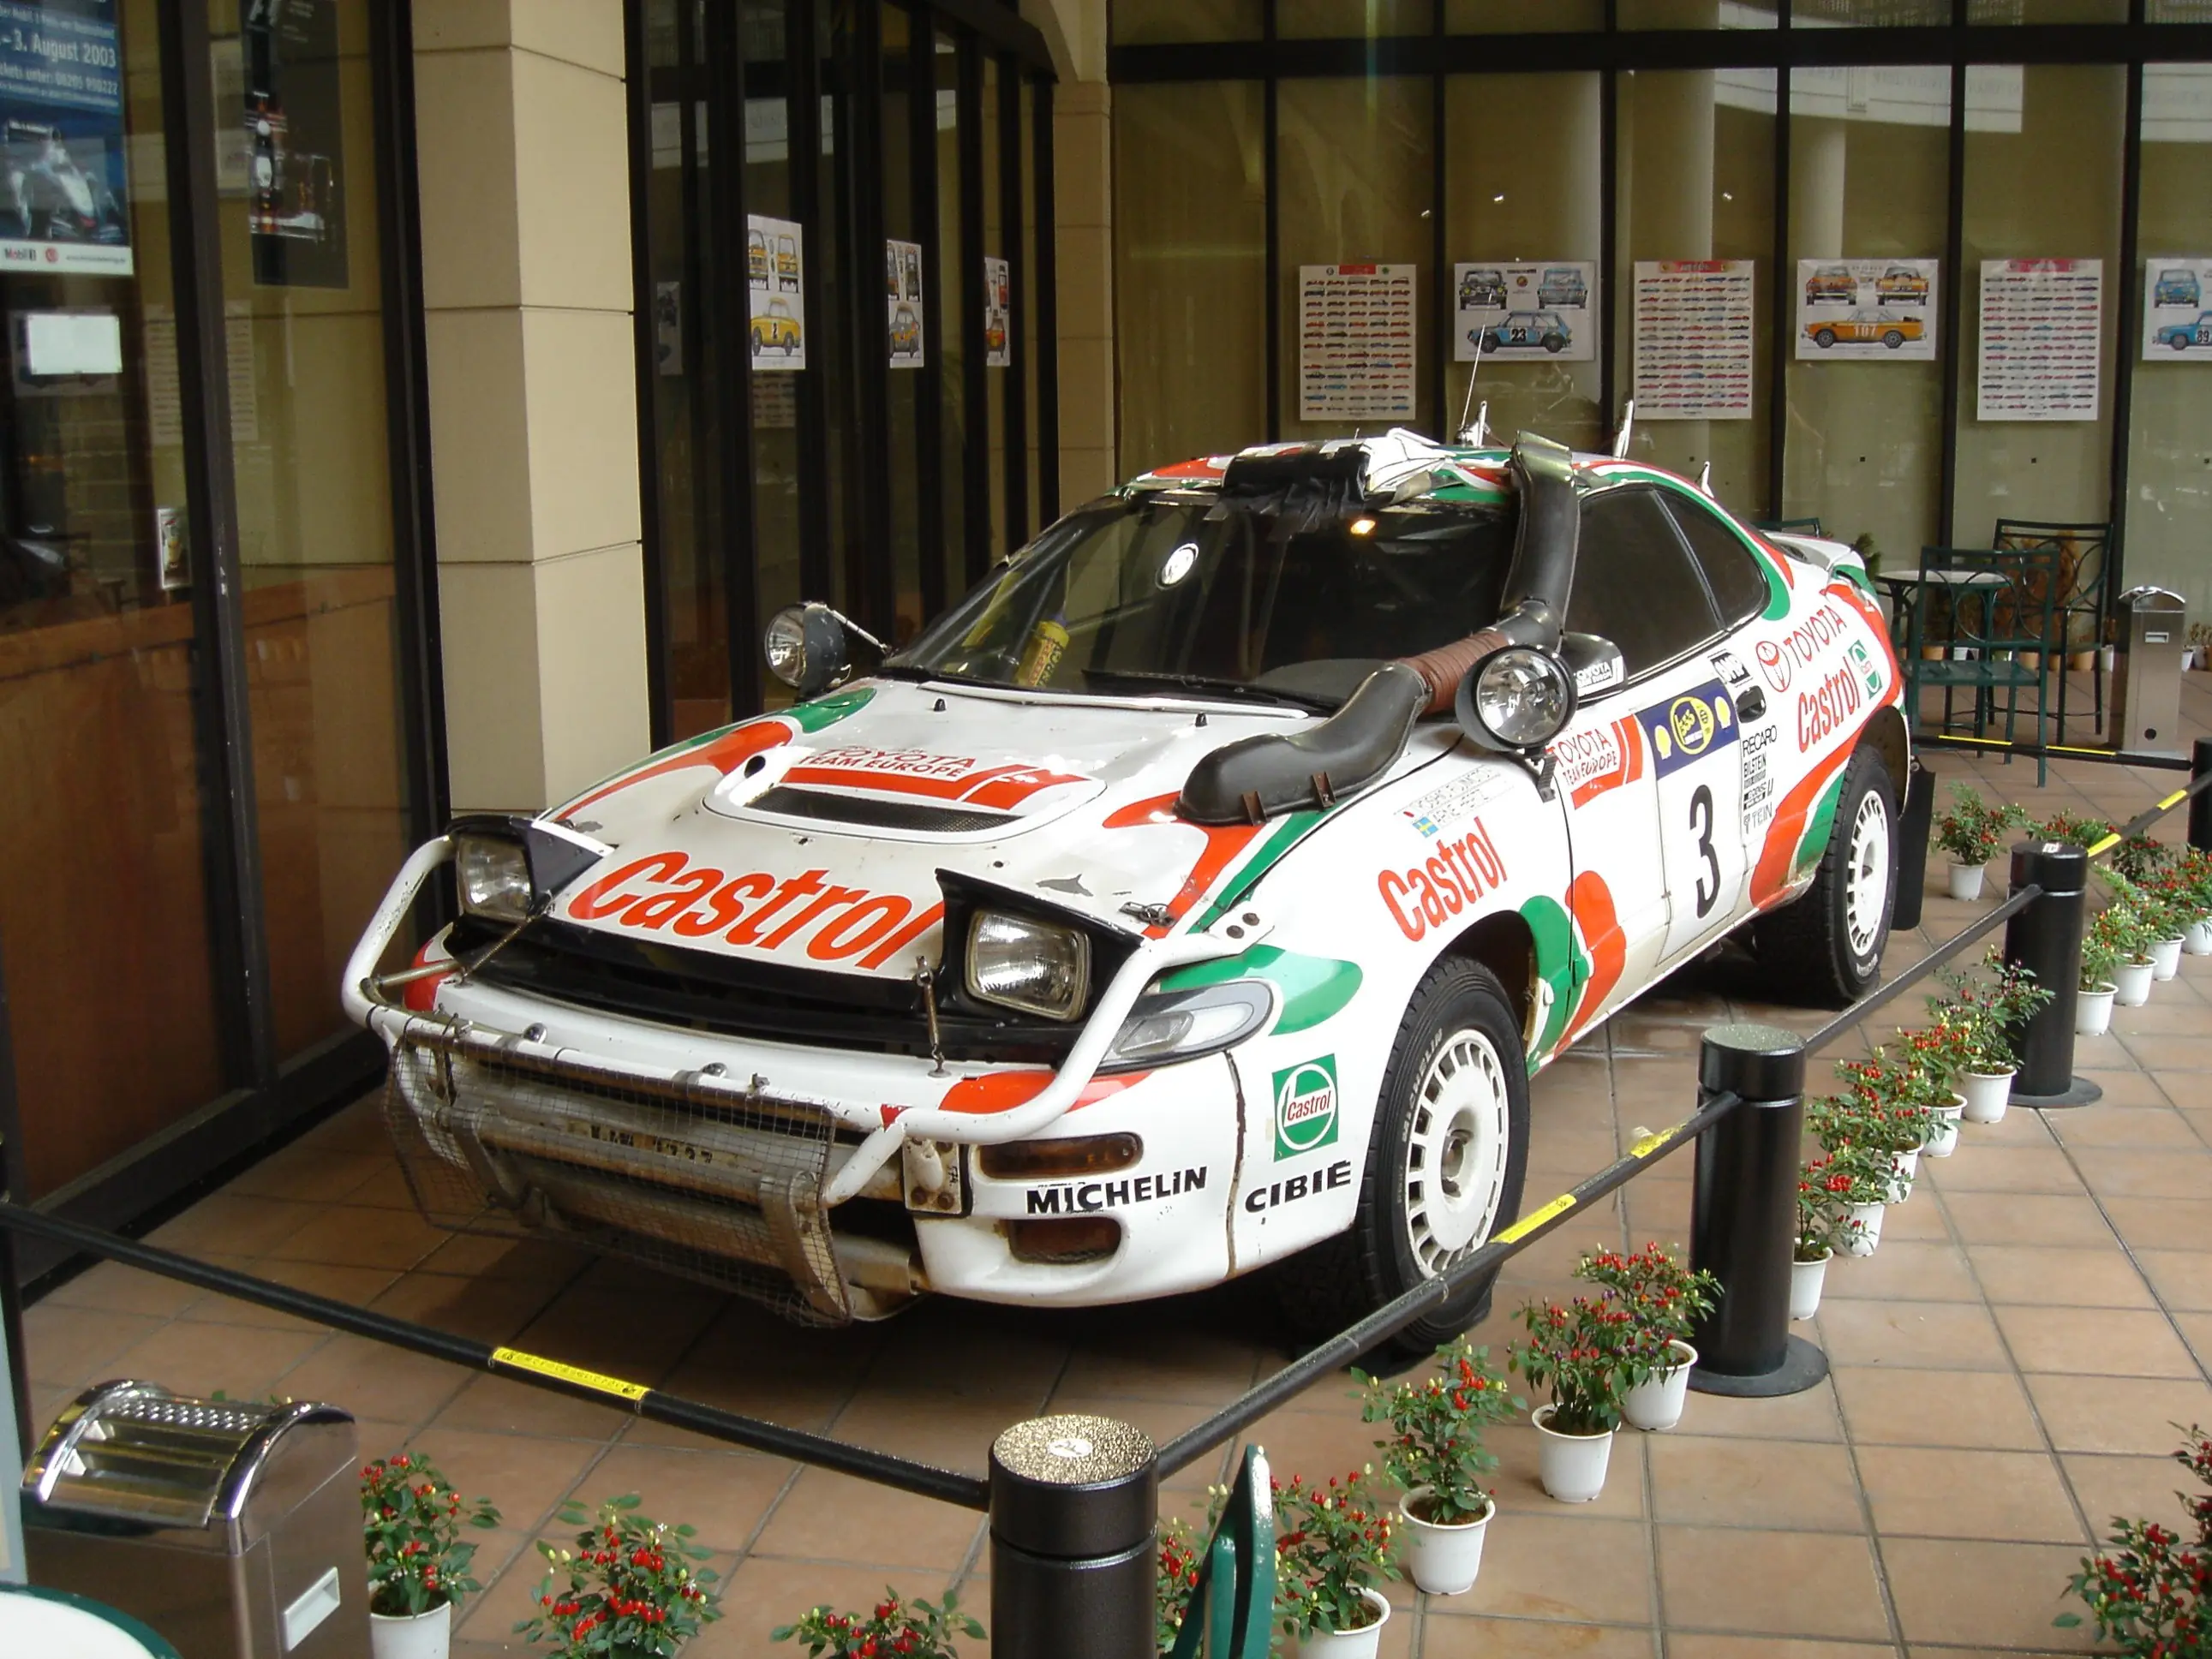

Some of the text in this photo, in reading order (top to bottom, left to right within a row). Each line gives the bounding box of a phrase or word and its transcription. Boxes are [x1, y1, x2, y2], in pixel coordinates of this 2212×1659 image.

[33, 33, 79, 63] August
[84, 43, 117, 69] 2003
[1511, 328, 1527, 343] 23
[2197, 330, 2209, 343] 89
[1784, 605, 1847, 668] TOYOTA
[1573, 661, 1612, 682] OYOTA
[1798, 656, 1861, 754] Castrol
[816, 743, 977, 769] TOYOTA
[1544, 728, 1612, 768] TOYOTA
[1742, 724, 1778, 758] RECARO
[798, 755, 969, 779] TEAM EUROPE
[1581, 750, 1617, 778] EUROPE
[1689, 784, 1721, 919] 3
[1378, 816, 1508, 942] Castrol
[568, 850, 945, 970] Castrol
[1402, 1027, 1444, 1143] MICHELIN
[1287, 1089, 1331, 1121] Castrol
[1025, 1166, 1208, 1214] MICHELIN
